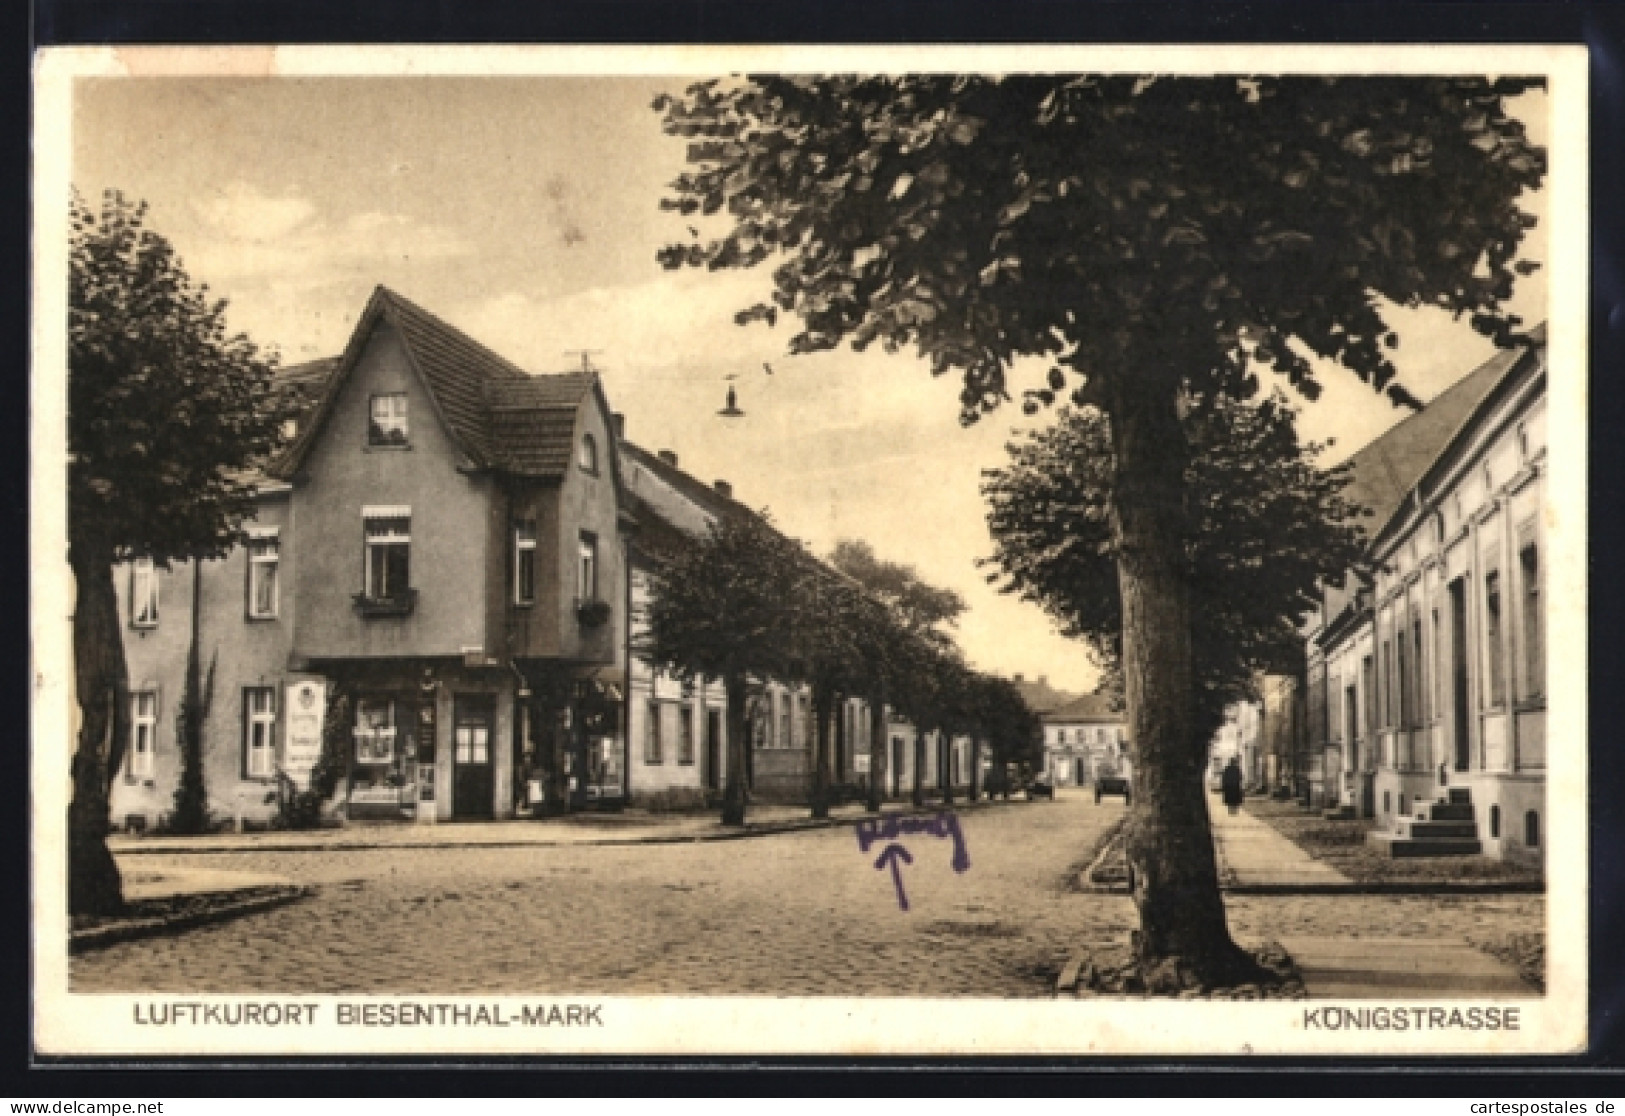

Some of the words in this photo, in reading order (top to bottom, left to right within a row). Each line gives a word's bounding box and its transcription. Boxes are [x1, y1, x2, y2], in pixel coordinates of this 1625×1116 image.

[133, 1003, 318, 1027] LUFTKURORT
[336, 1003, 604, 1028] BIESENTHAL-MARK
[1303, 1007, 1521, 1031] KÖNIGSTRASSE
